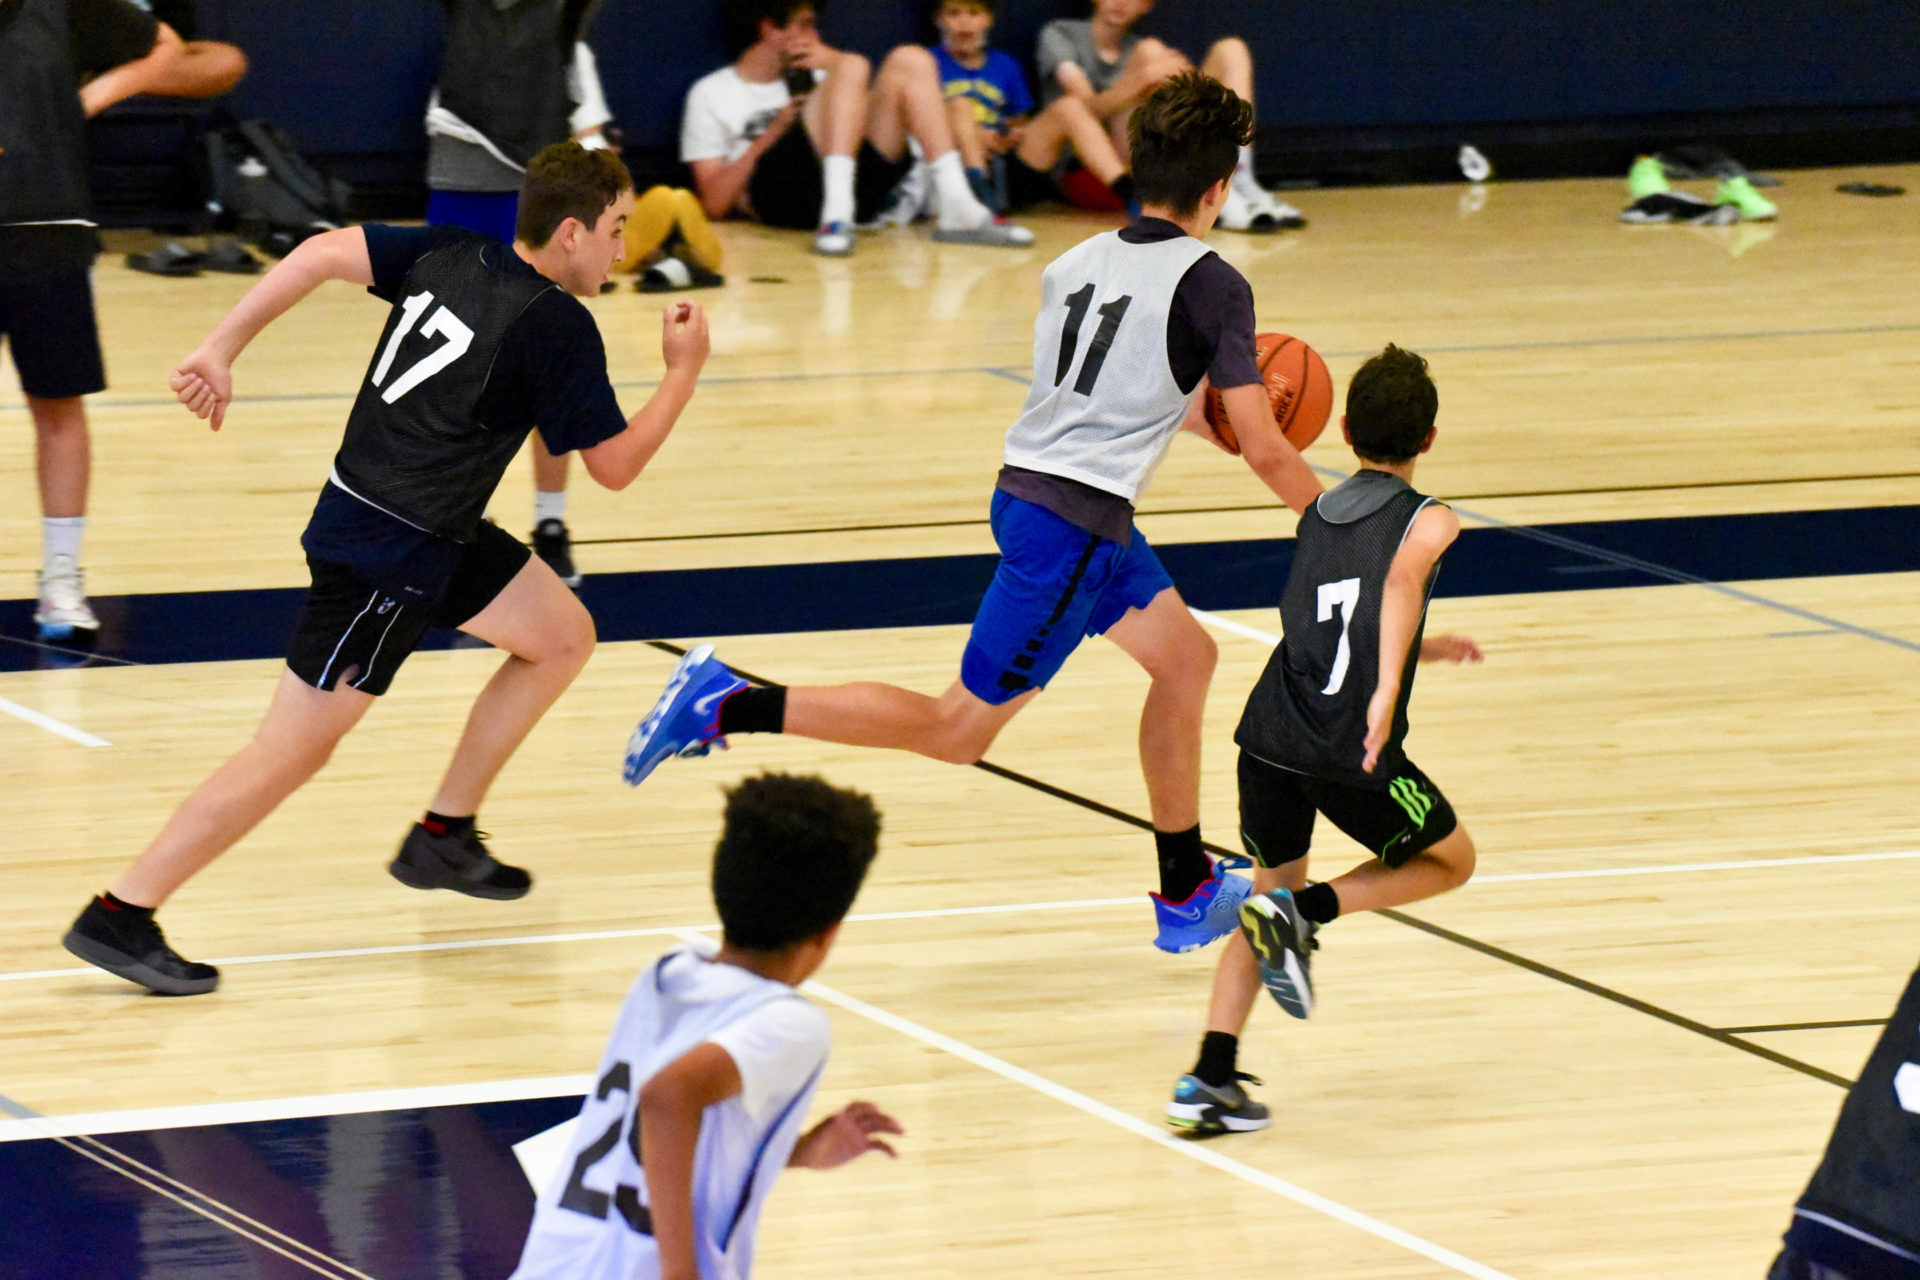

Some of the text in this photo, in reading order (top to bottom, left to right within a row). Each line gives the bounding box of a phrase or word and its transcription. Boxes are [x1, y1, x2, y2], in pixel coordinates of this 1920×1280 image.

[371, 290, 475, 405] 17
[1054, 282, 1133, 397] 11
[1316, 577, 1361, 696] 7
